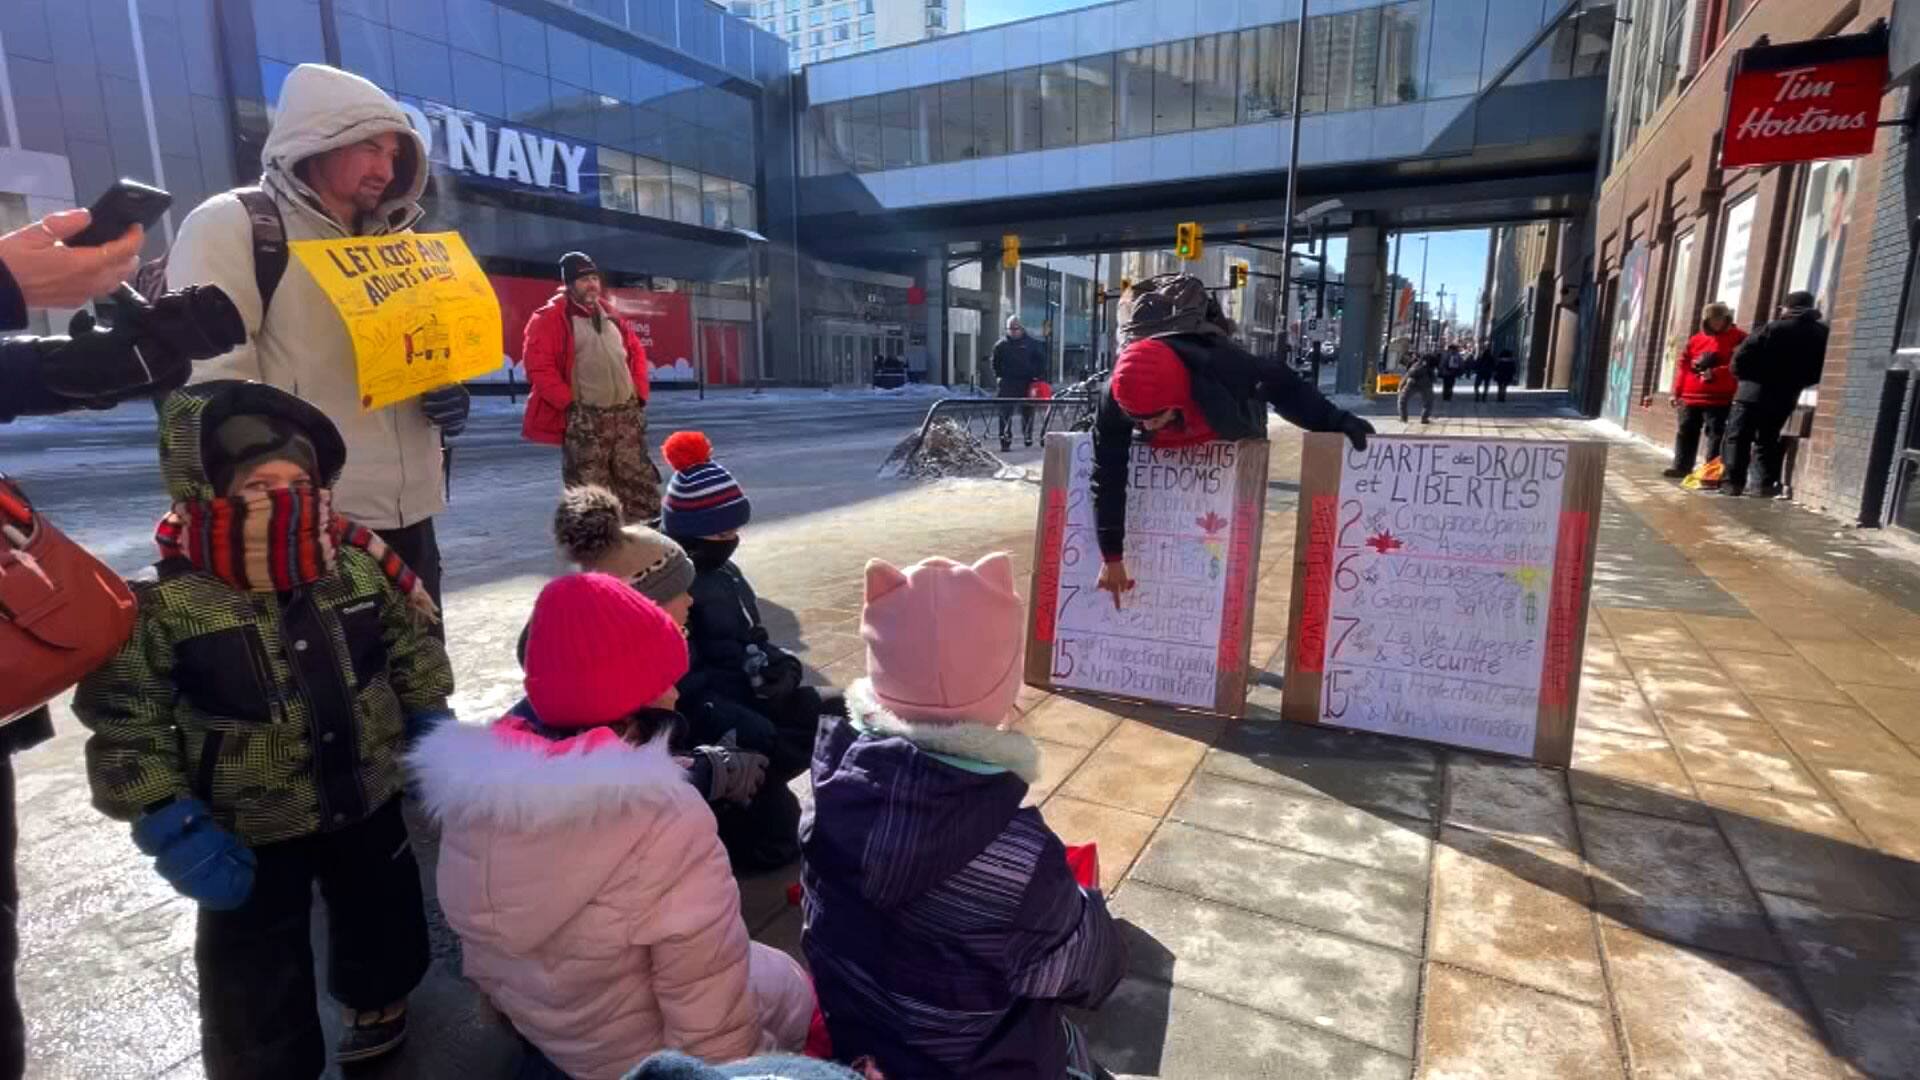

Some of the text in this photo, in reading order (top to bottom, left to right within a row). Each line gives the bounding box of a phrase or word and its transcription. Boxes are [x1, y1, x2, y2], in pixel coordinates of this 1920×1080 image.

[1775, 67, 1834, 102] Tim
[1736, 107, 1867, 140] Hortons
[446, 113, 586, 194] NAVY
[326, 246, 379, 278] LET
[1126, 464, 1222, 494] EEDOMS
[1347, 445, 1449, 475] CHARTE
[1475, 447, 1566, 480] DROITS
[1355, 475, 1380, 493] et
[1338, 500, 1363, 549] 2
[1063, 532, 1080, 566] 6
[1335, 554, 1360, 592] 6
[1058, 585, 1080, 619] 7
[1332, 616, 1360, 658] 7
[1051, 639, 1075, 679] 15
[1322, 670, 1353, 719] 15
